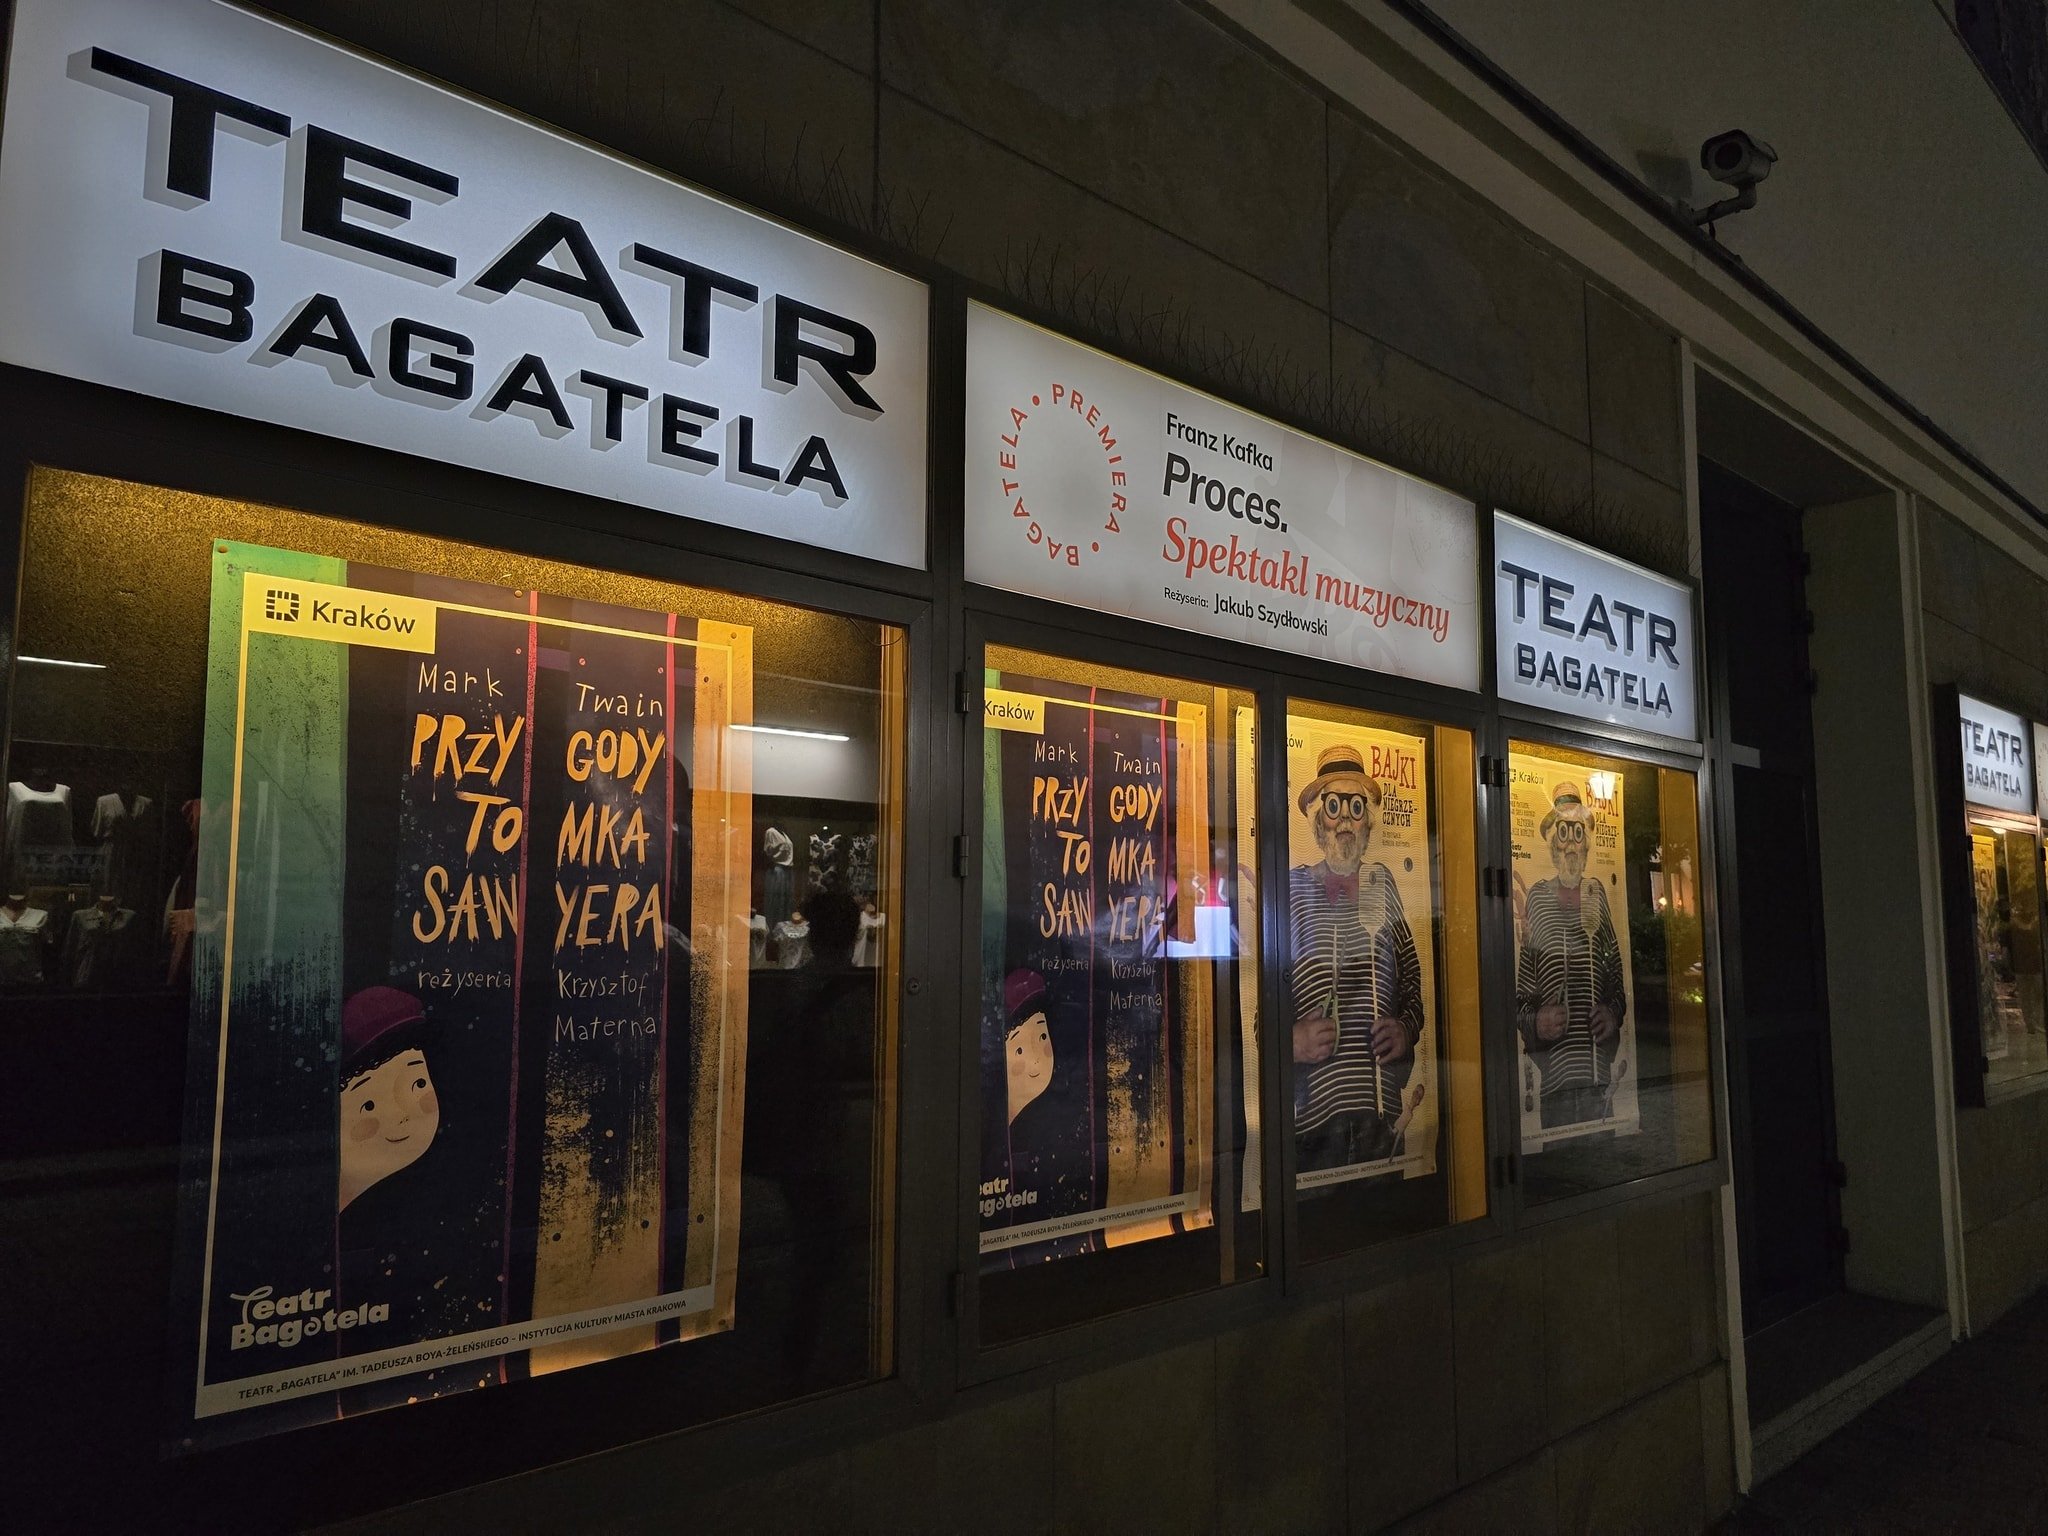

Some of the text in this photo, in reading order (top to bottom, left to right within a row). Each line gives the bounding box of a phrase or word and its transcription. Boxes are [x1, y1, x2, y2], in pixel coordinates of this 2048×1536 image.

[67, 46, 884, 420] TEATR
[133, 249, 849, 509] BAGATELA
[1052, 384, 1127, 534] PREMIERA
[1166, 412, 1273, 472] Franz Kafka
[1000, 407, 1080, 567] BAGATELA
[1163, 452, 1288, 533] Proces.
[1162, 517, 1450, 643] Spektakl muzyczny
[311, 599, 416, 635] Kraków
[1164, 587, 1328, 636] Reżyseria: Jakub Szydłowski
[1497, 559, 1681, 671] TEATR
[418, 661, 664, 718] Mark Twain
[1514, 643, 1673, 719] BAGATELA
[983, 700, 1035, 721] Kraków
[411, 713, 667, 797] PRZY GODY
[1034, 741, 1161, 775] Mark Twain
[1371, 745, 1417, 789] BAJKI
[1960, 717, 2024, 767] TEATR
[1032, 776, 1162, 831] PRZY GODY
[1383, 783, 1397, 797] DLA
[1966, 762, 2022, 799] BAGATELA
[455, 790, 651, 869] TO MKA
[1382, 811, 1411, 827] CZNYCH
[1056, 830, 1156, 885] TO MKA
[412, 865, 665, 953] SAW YERA
[1040, 883, 1165, 943] SAW YERA
[418, 967, 648, 1001] reżyseria Krzysztof
[1110, 990, 1163, 1011] Materna
[555, 1014, 657, 1044] Materna
[230, 1285, 331, 1325] Teatr
[231, 1302, 390, 1350] Bagatela
[238, 1384, 274, 1400] TEATR
[343, 1368, 359, 1378] IM.
[361, 1355, 413, 1374] TADEUSZA
[416, 1337, 509, 1363] BOYA-ŻELEŃSKIEGO
[518, 1324, 573, 1342] INSTYTUCJA
[574, 1316, 613, 1331] KULTURY
[614, 1309, 646, 1323] MIASTA
[647, 1300, 687, 1316] KRAKOWA
